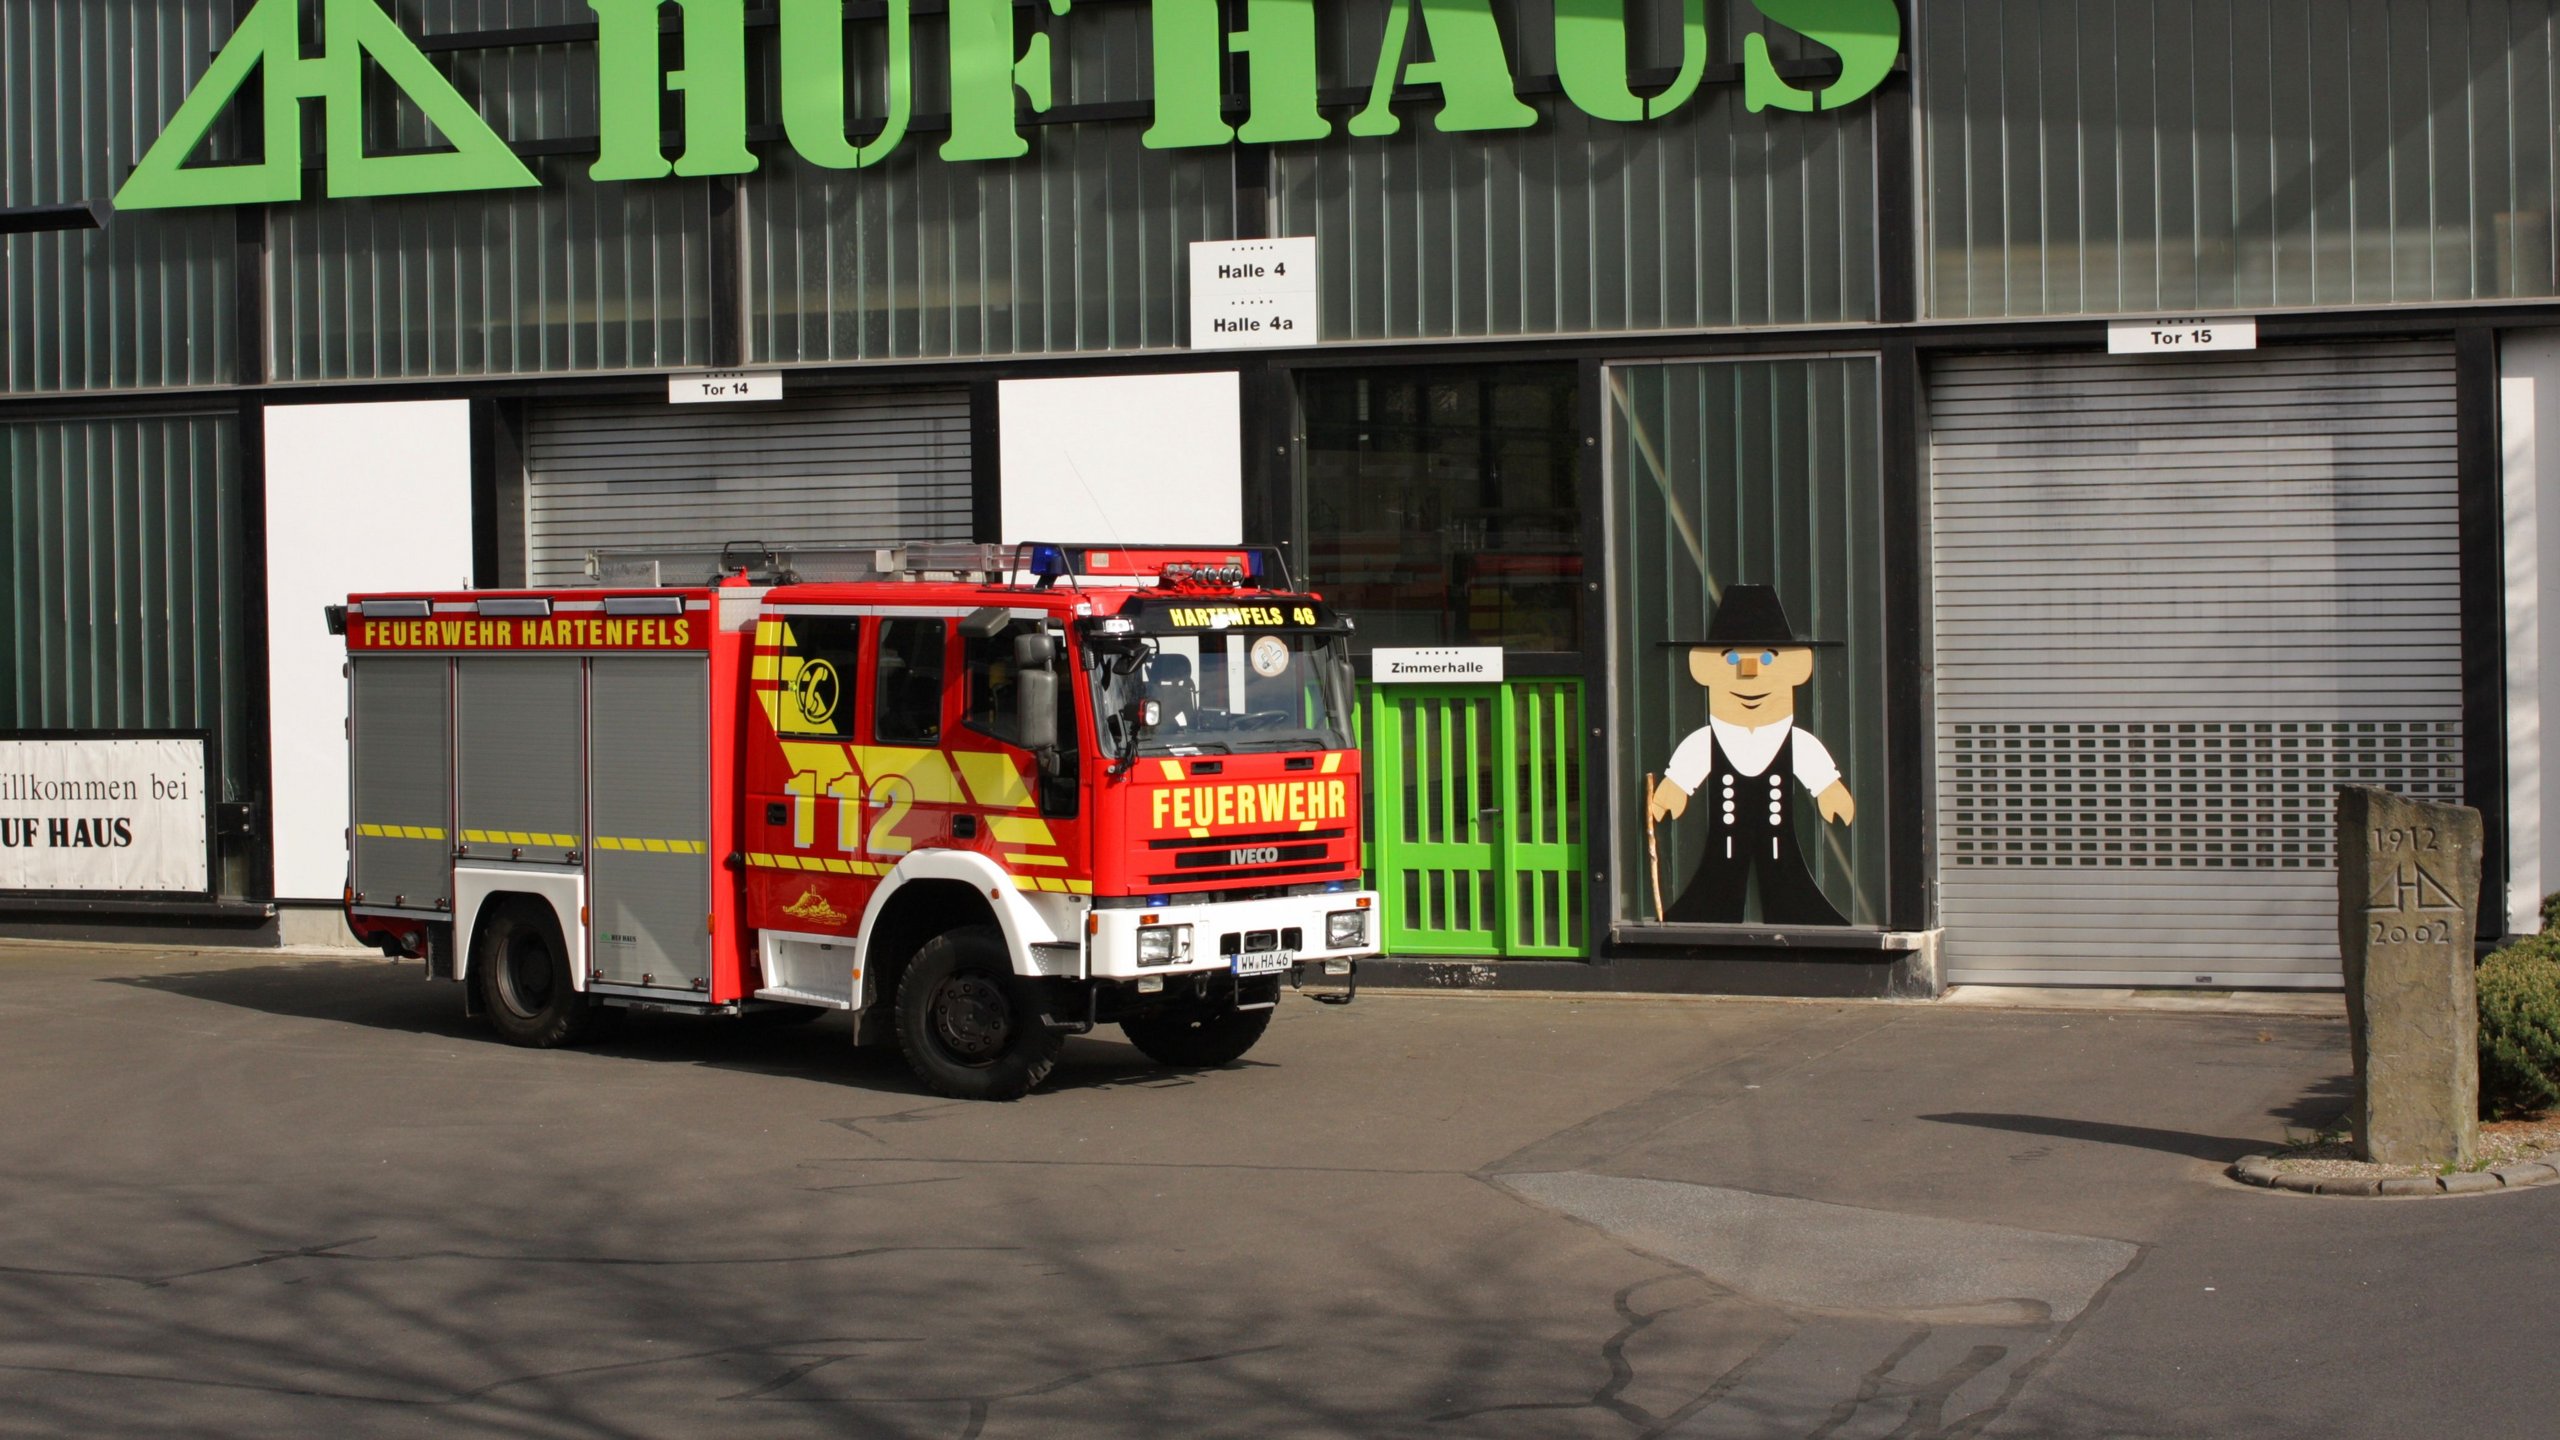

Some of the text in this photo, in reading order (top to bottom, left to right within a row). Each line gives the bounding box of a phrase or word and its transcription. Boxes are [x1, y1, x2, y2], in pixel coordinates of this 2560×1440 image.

[589, 0, 1070, 181] HUF
[1218, 262, 1286, 279] Halle 4
[1213, 316, 1293, 332] Halle 4a
[2151, 329, 2212, 344] Tor 15
[702, 382, 748, 395] Tor 14
[1293, 607, 1316, 625] 46
[364, 618, 690, 646] FEUERWEHR HARTENFELS
[1391, 661, 1483, 674] Zimmerhalle
[0, 772, 189, 801] illkommen bei
[784, 770, 915, 857] 112
[1152, 780, 1346, 829] FEUERWEHR
[48, 816, 133, 848] HAUS
[2373, 826, 2439, 852] 1912
[1230, 847, 1278, 865] IVECO
[2370, 919, 2450, 946] 2002
